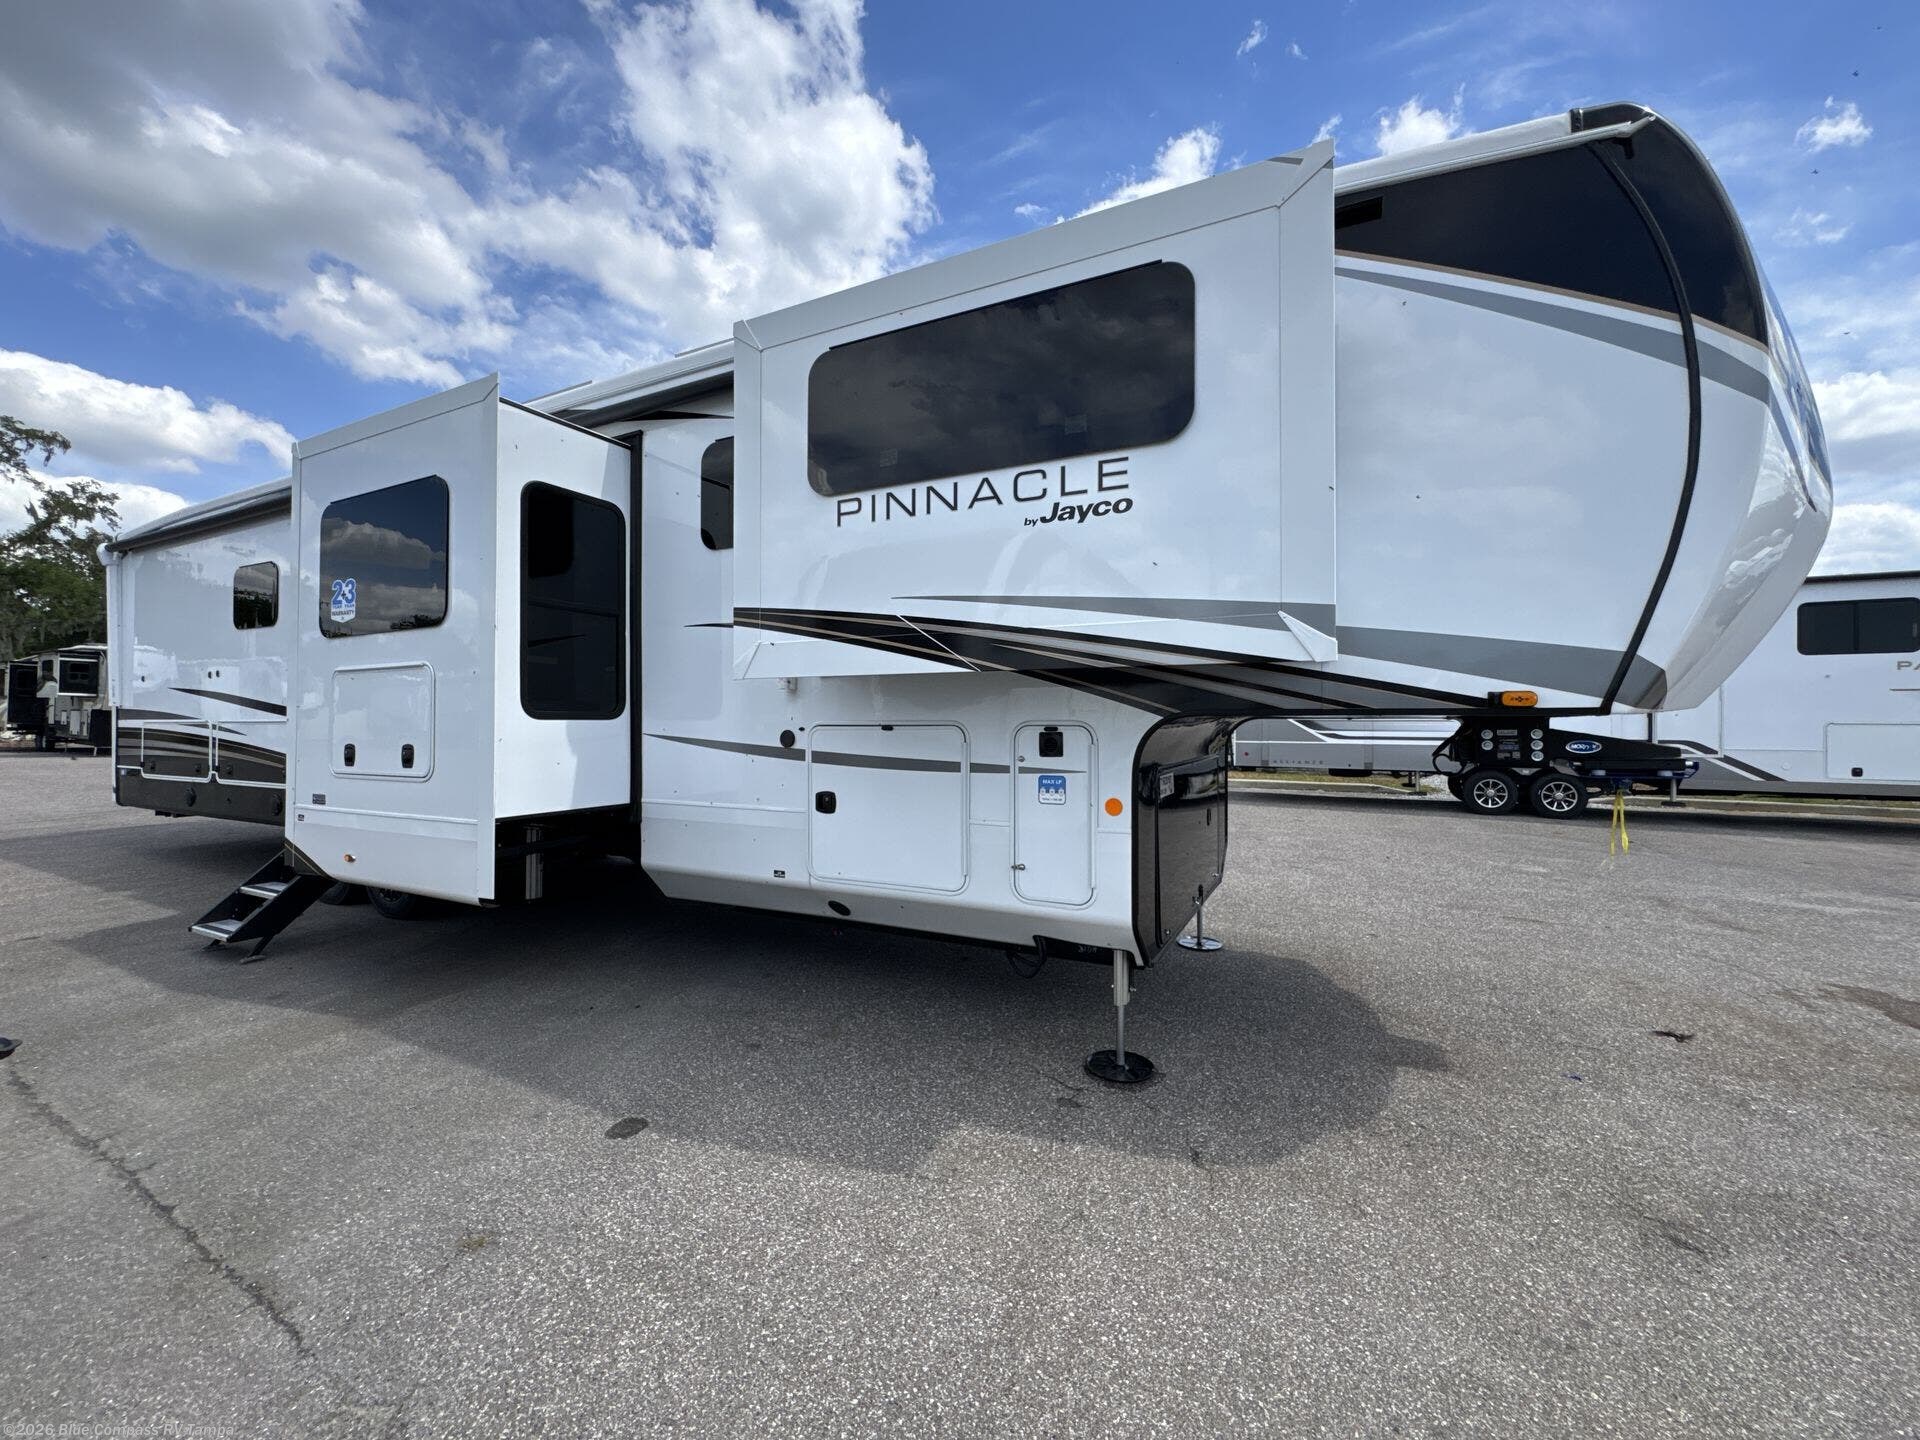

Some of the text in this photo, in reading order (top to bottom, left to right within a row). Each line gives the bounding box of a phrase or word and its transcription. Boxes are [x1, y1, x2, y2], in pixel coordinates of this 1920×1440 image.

[837, 456, 1129, 527] PINNACLE
[1024, 498, 1133, 527] by Jayco
